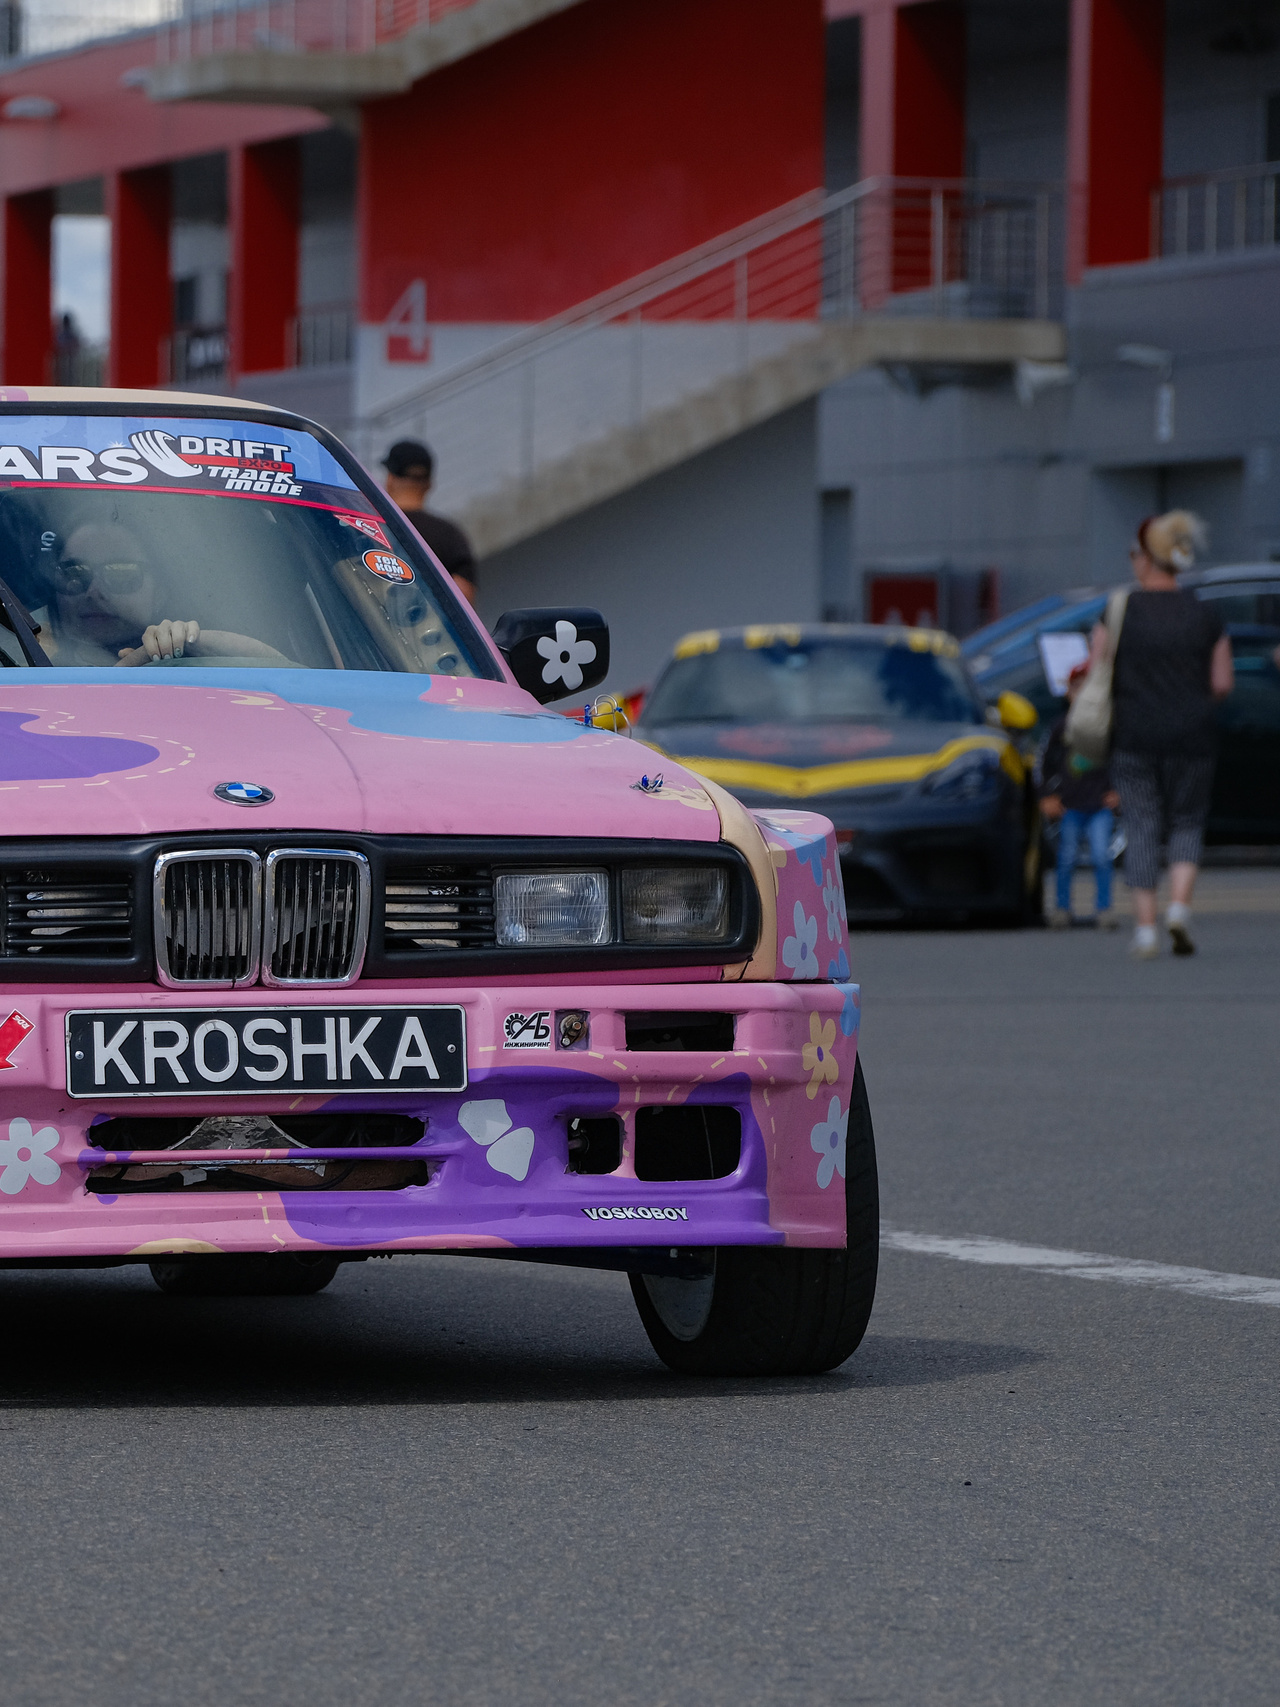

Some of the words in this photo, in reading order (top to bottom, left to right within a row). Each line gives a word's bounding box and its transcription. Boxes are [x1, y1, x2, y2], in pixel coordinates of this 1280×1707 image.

[382, 279, 427, 355] 4
[180, 436, 290, 462] DRIFT
[237, 458, 283, 470] EXPO
[207, 466, 296, 485] TRACK
[224, 479, 304, 496] MODE
[93, 1016, 440, 1085] KROSHKA
[581, 1206, 689, 1221] VOSKOBOY
